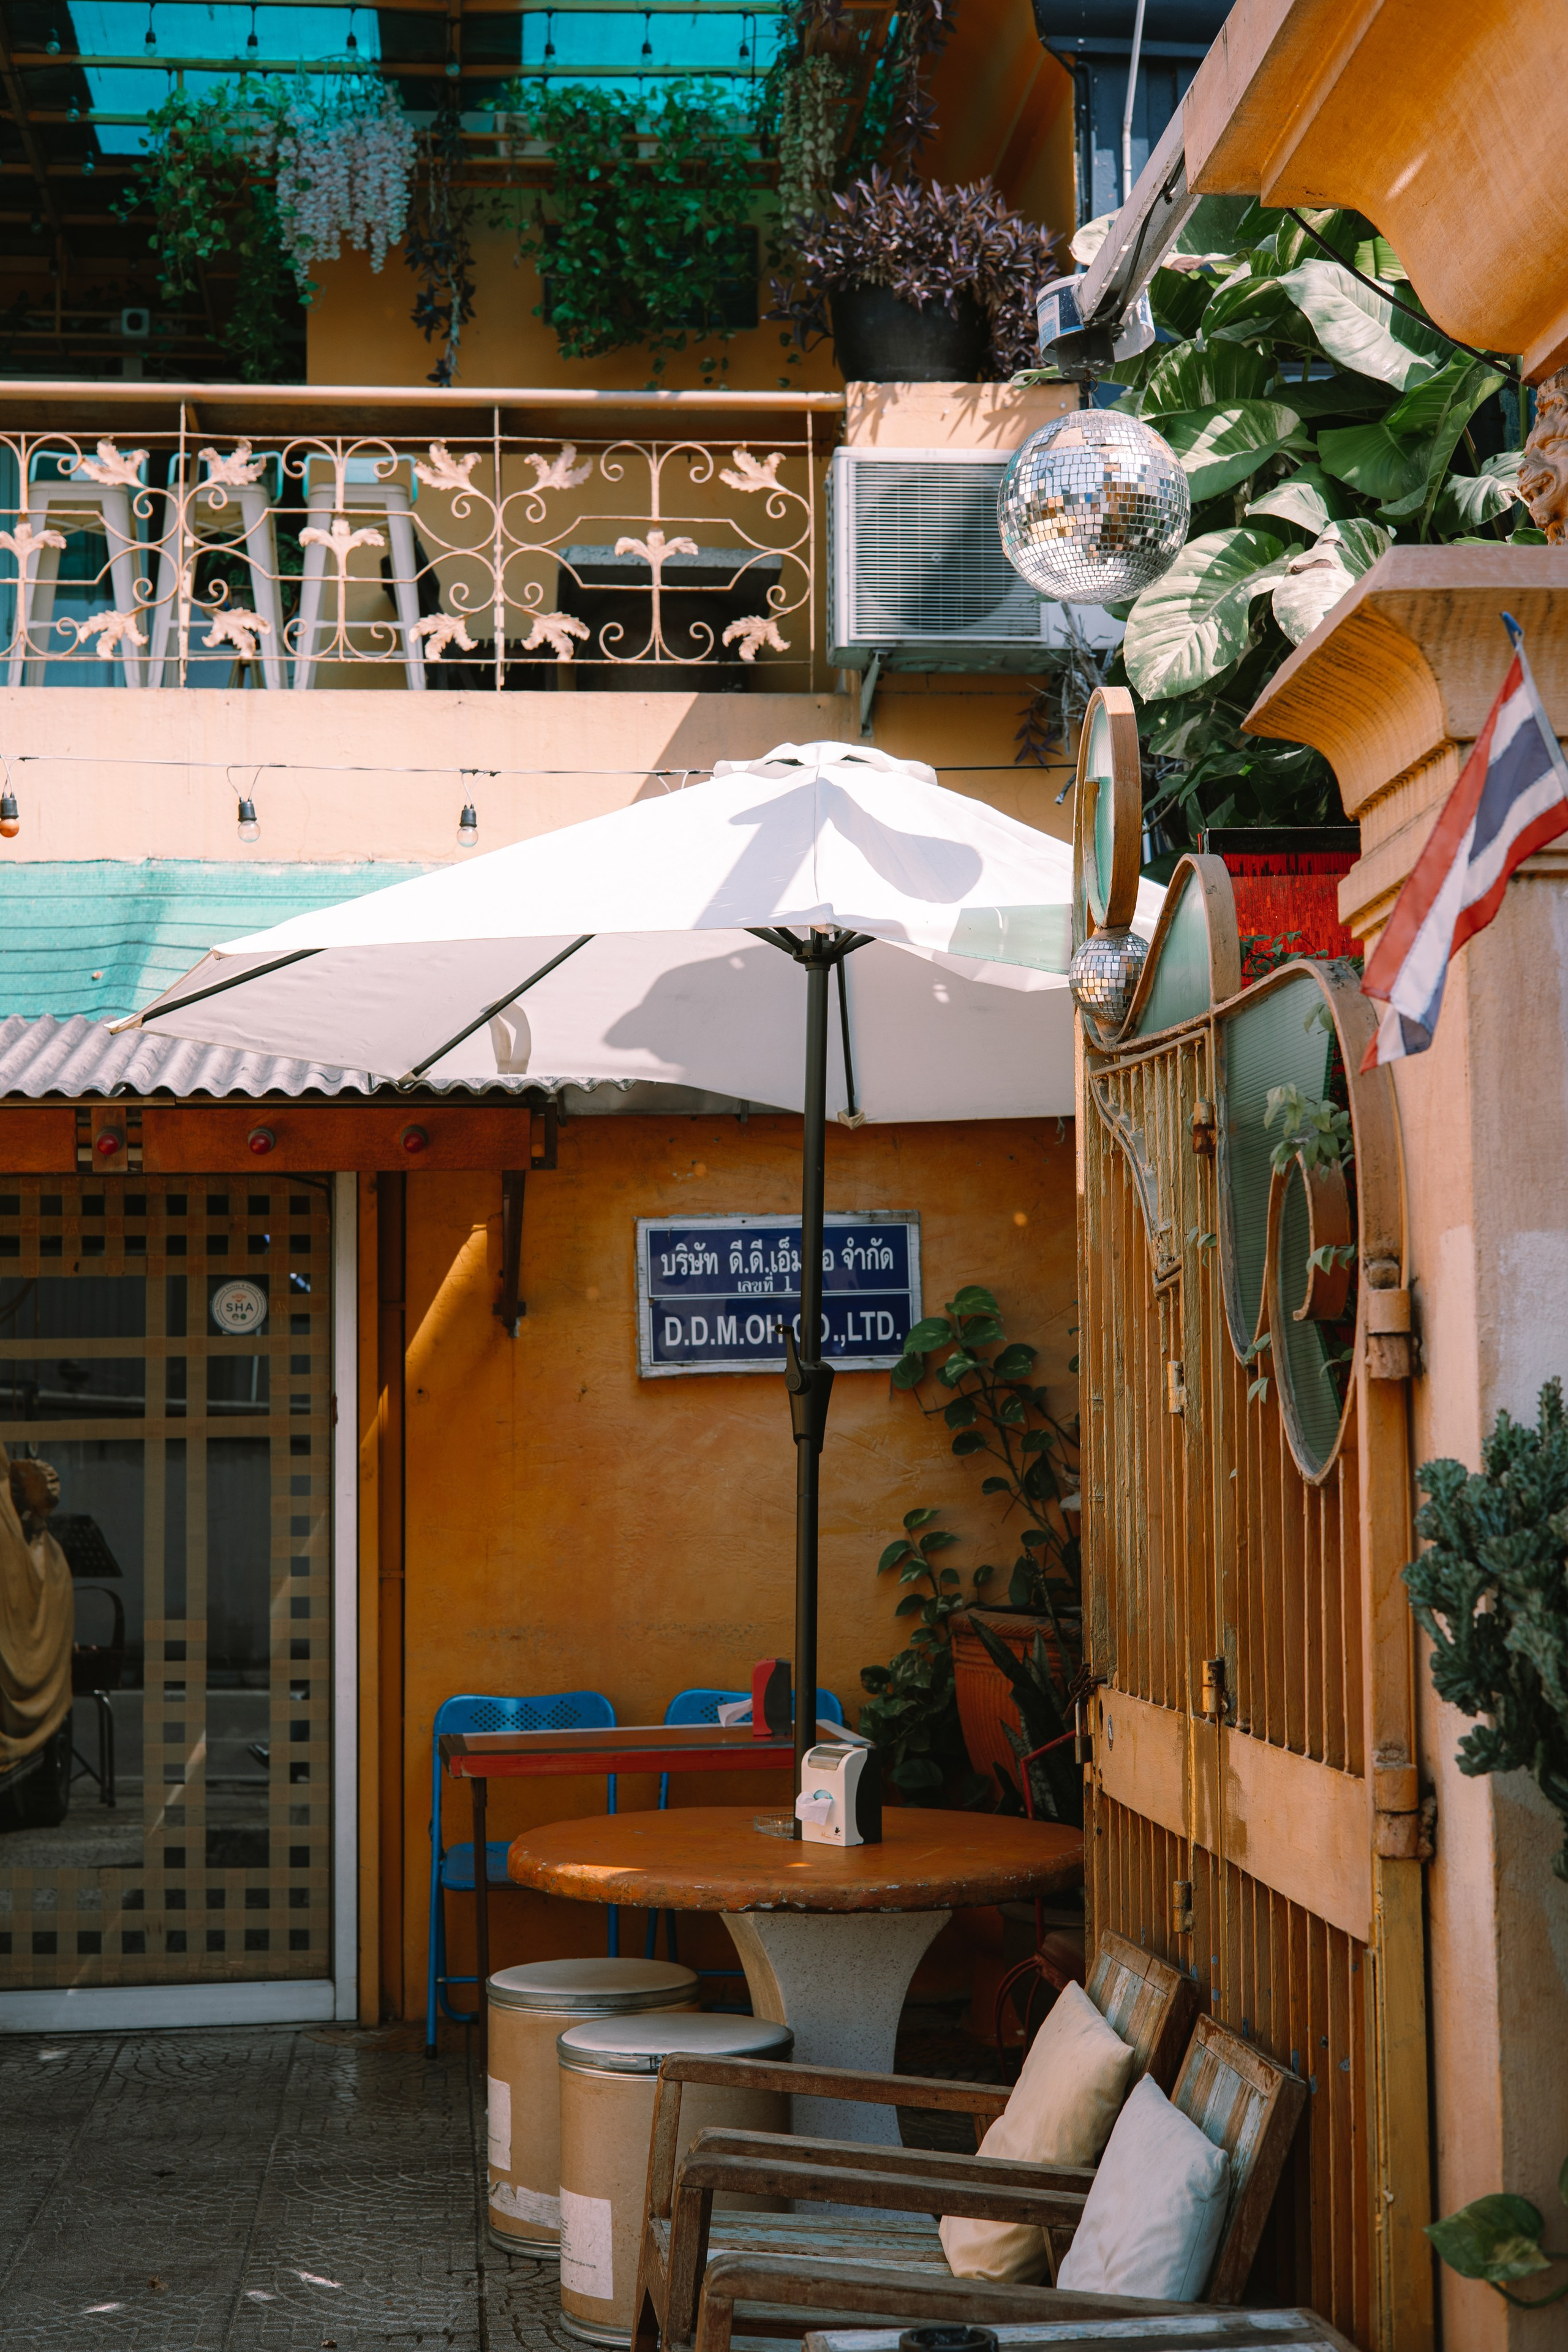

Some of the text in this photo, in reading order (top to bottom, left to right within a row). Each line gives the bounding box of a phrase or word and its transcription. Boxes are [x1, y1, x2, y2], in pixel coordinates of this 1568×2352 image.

[660, 1242, 718, 1276] บริษัท
[841, 1237, 894, 1271] จำกัด
[737, 1272, 793, 1293] เลขที่ 1
[226, 1302, 254, 1312] SHA
[665, 1314, 783, 1347] D.D.M.OH
